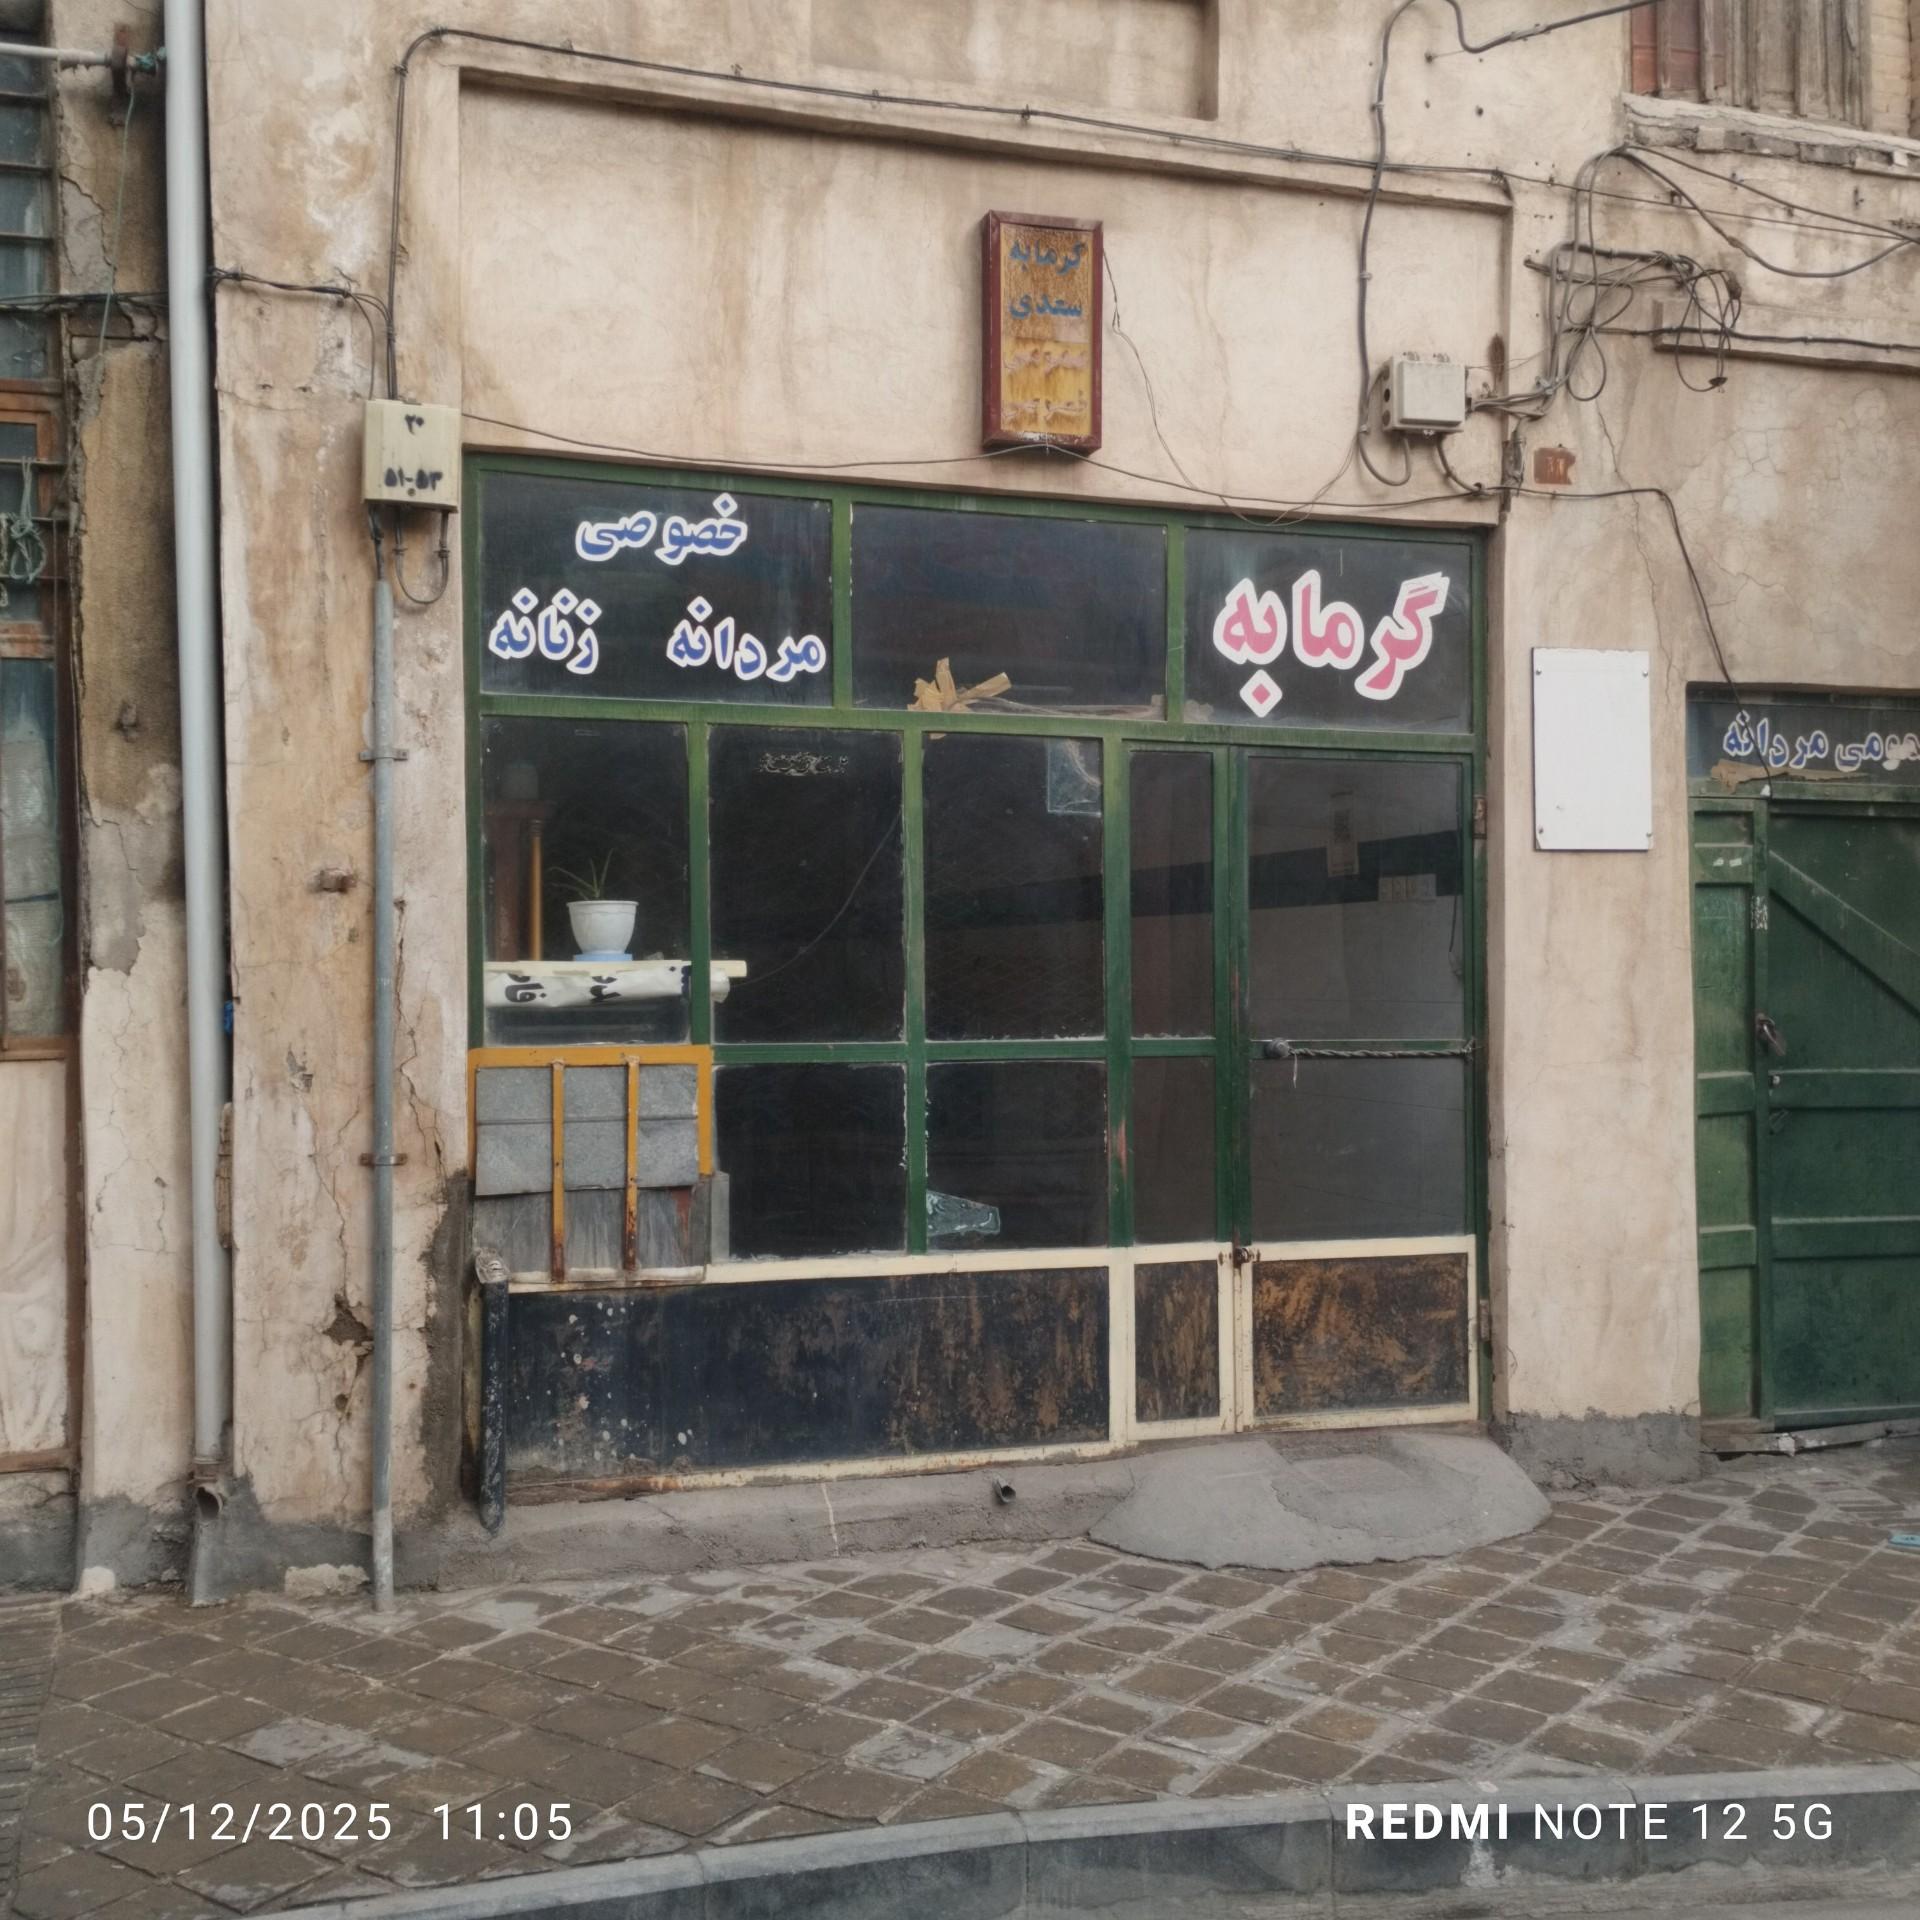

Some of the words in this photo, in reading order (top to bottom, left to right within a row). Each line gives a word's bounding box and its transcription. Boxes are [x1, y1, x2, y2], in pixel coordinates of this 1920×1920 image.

[575, 493, 747, 565] خصوصی
[487, 587, 602, 675] زنانه
[666, 595, 826, 682] مردانه
[1213, 569, 1450, 718] گرمابه
[1723, 709, 1829, 769] مردانه
